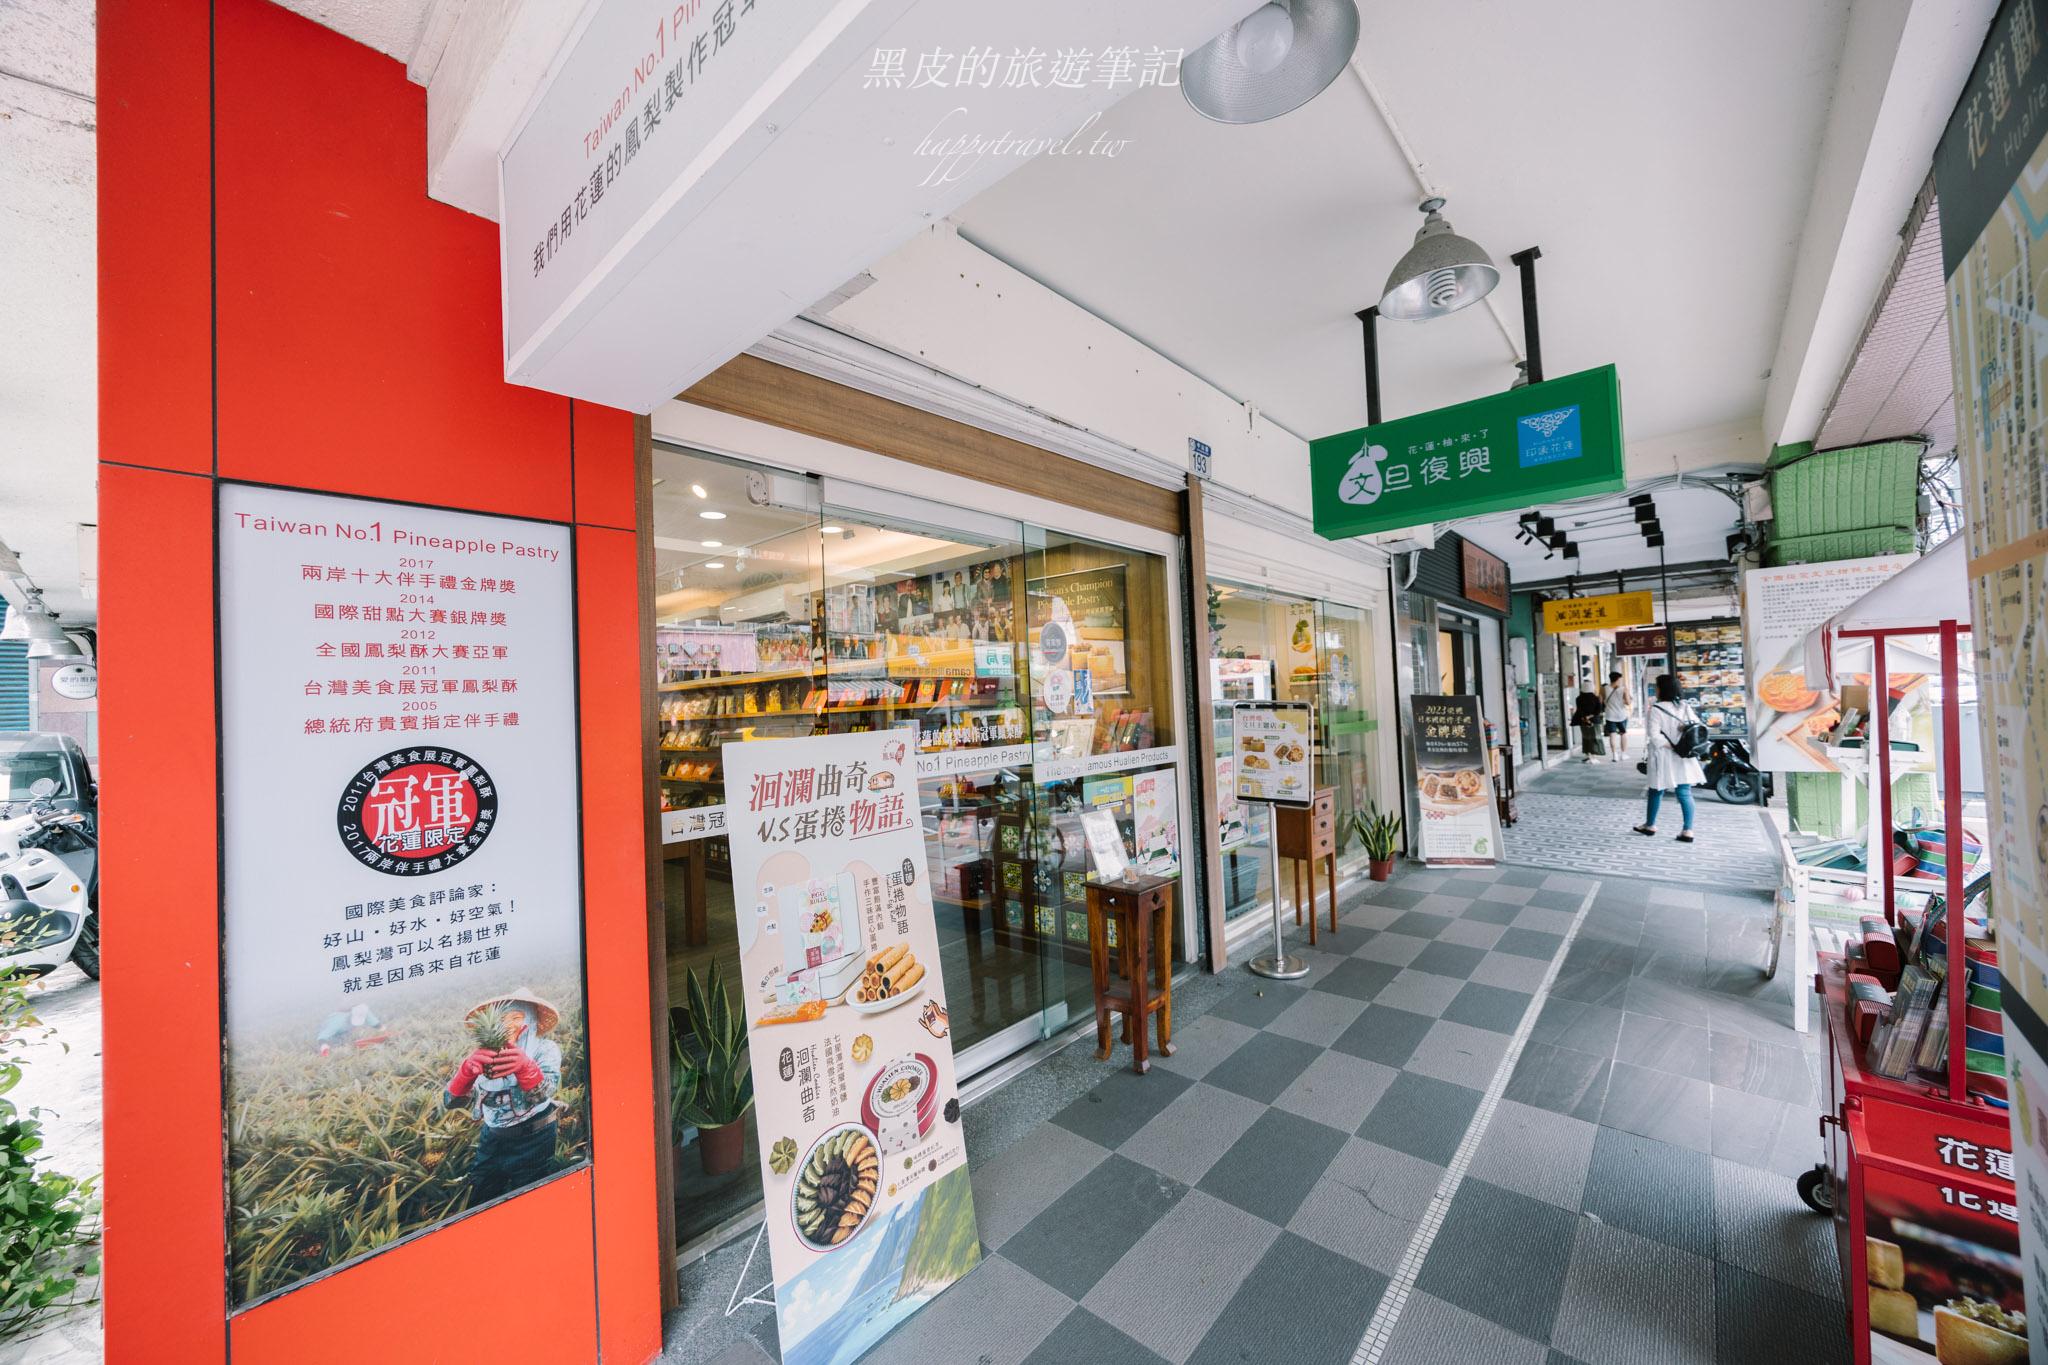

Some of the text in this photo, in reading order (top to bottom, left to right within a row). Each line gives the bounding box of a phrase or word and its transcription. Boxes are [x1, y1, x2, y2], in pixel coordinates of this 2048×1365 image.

[584, 87, 630, 160] Taiwan
[634, 16, 665, 93] No.1
[533, 0, 756, 278] 我們用花蓮的鳳梨製作冠
[1193, 453, 1207, 474] 193
[235, 512, 560, 563] Taiwan No.1 Pineapple Pastry
[399, 557, 434, 569] 2017
[300, 563, 517, 594] 兩岸十大伴手禮金牌獎
[399, 593, 435, 605] 2014
[314, 603, 508, 626] 國際甜點大賽銀牌獎
[400, 629, 436, 640] 2012
[315, 642, 509, 660] 全國鳳梨酥大賽亞軍
[402, 665, 437, 676] 2011
[303, 679, 519, 697] 台灣美食展冠軍鳳梨酥
[402, 701, 438, 712] 2005
[303, 712, 520, 735] 總統府貴賓指定伴手禮
[916, 749, 1031, 773] No.1 Pineapple Pastry
[1113, 754, 1140, 767] Hualien
[1140, 751, 1169, 763] Products
[749, 760, 868, 812] 洄瀾曲奇
[370, 772, 471, 845] 冠軍
[377, 826, 467, 854] 花蓮限定
[891, 870, 909, 935] 蛋捲物語
[331, 922, 509, 973] 鳳梨灣可以名揚世界
[796, 1047, 815, 1124] 洄瀾曲奇
[876, 1063, 925, 1094] HUALIEN COOKIES
